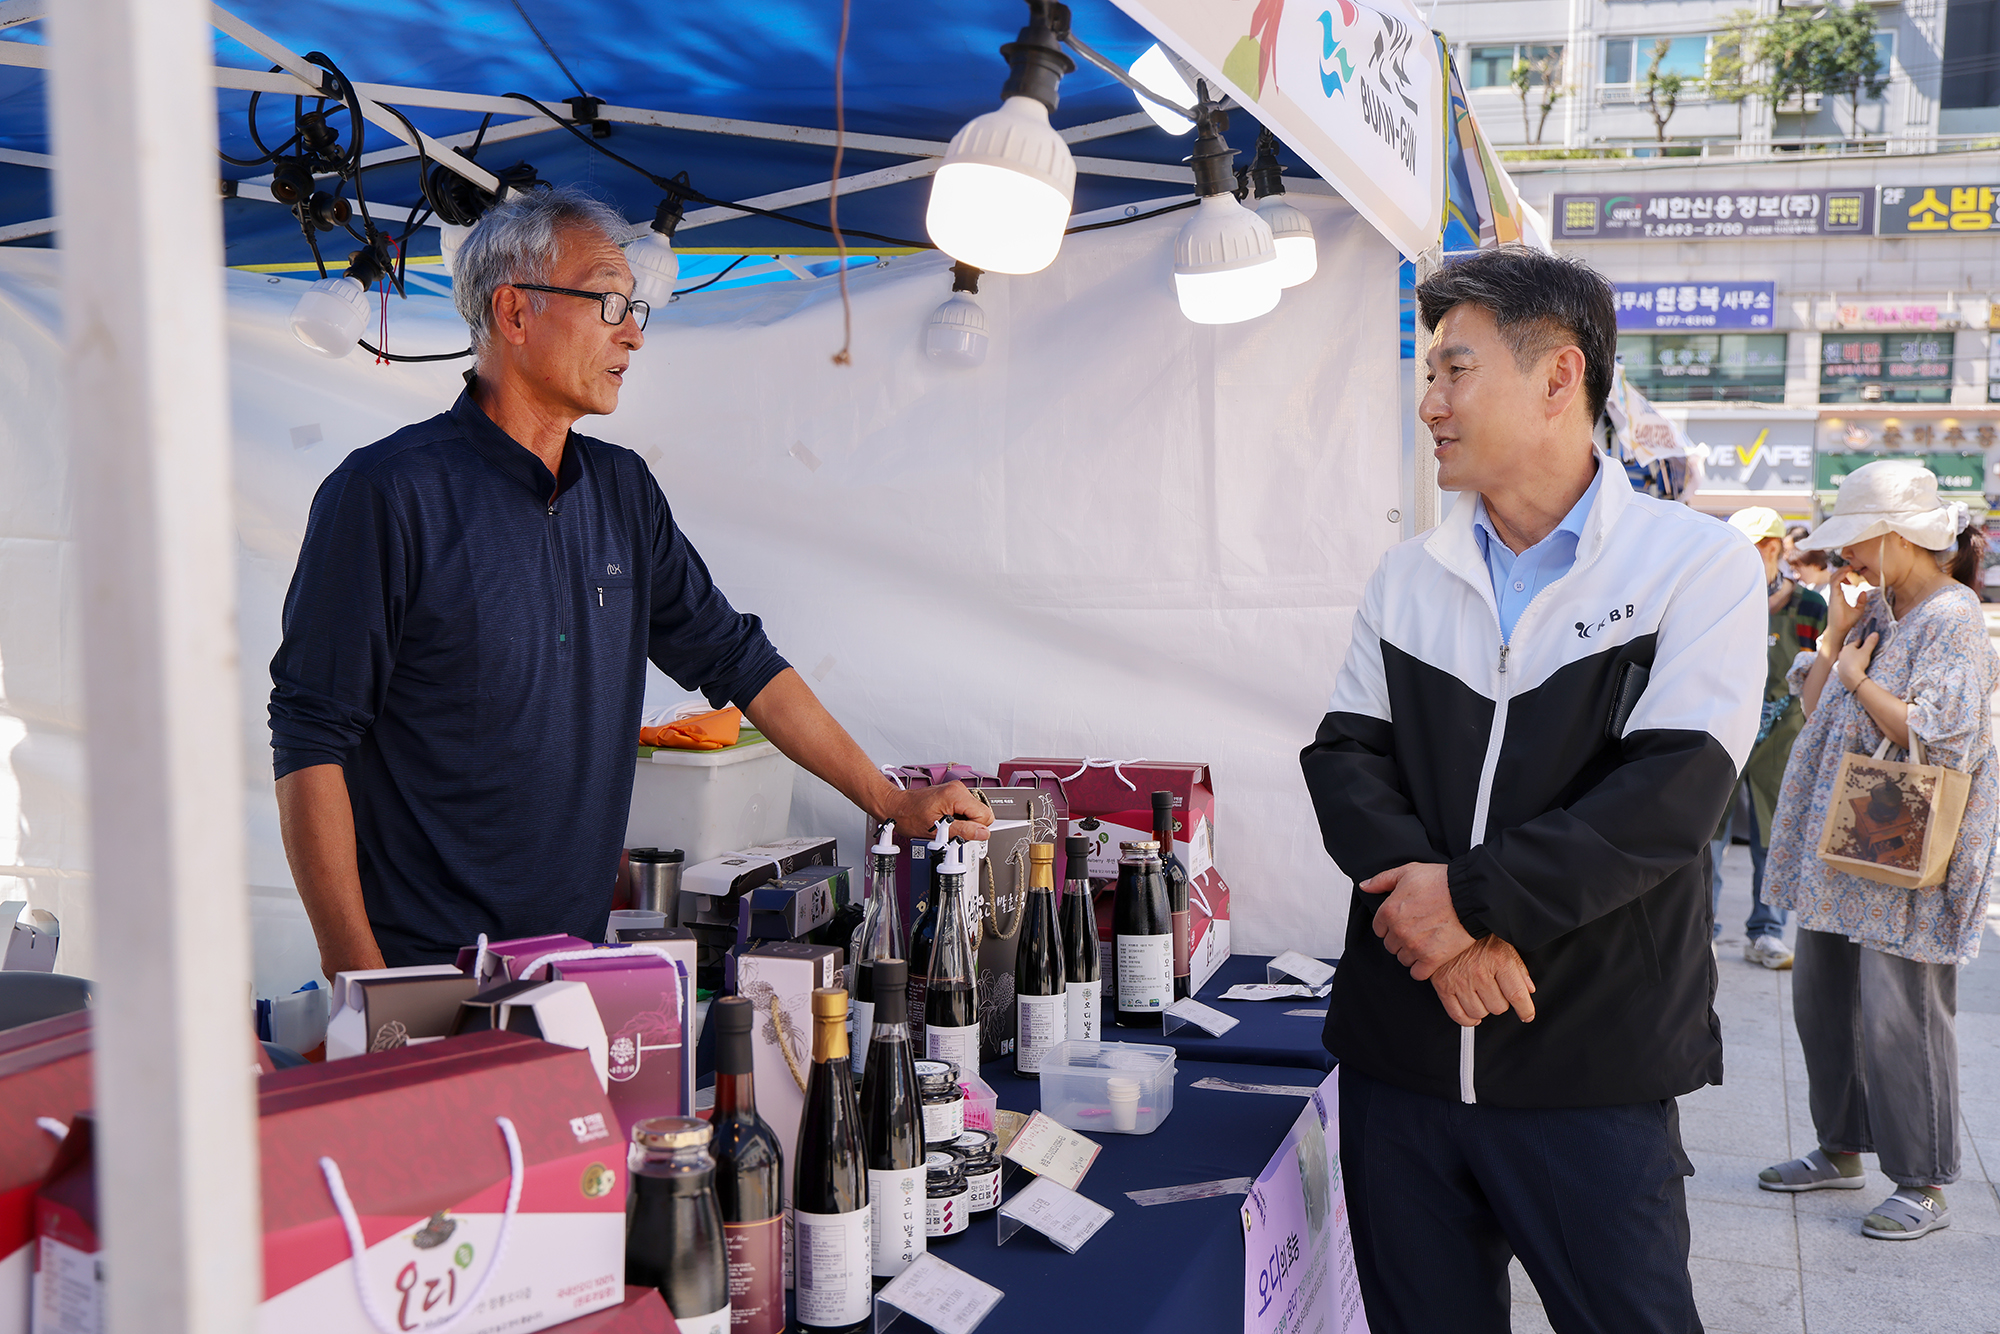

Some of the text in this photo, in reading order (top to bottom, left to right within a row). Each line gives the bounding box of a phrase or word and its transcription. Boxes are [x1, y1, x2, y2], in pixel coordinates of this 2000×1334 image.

[1646, 194, 1820, 220] 새한신용정보(주)
[1722, 290, 1771, 310] 사무소
[971, 1191, 991, 1202] 오디잼
[395, 1260, 457, 1332] 오디
